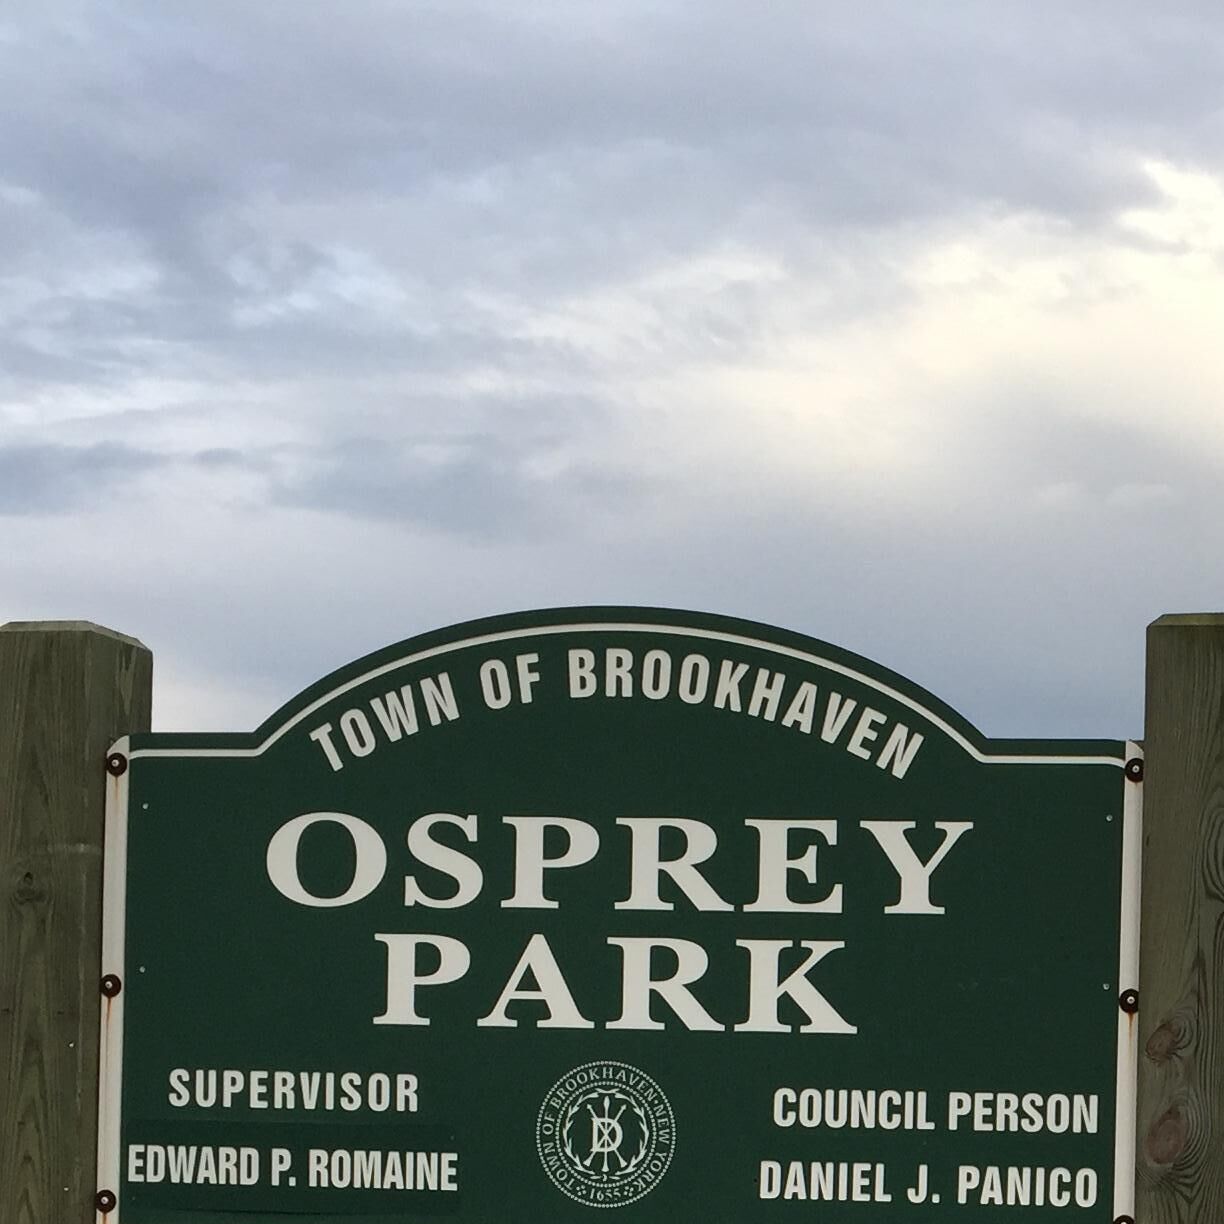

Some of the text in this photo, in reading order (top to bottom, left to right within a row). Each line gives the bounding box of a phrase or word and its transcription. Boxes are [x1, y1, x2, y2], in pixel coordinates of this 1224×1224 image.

[309, 645, 924, 780] TOWN OF BROOKHAVEN
[266, 811, 974, 915] OSPREY
[372, 933, 858, 1035] PARK
[168, 1068, 420, 1112] SUPERVISOR
[773, 1087, 1099, 1134] COUNCIL PERSON
[127, 1144, 459, 1191] EDWARD P. ROMAINE
[759, 1160, 1098, 1208] DANIEL J. PANICO
